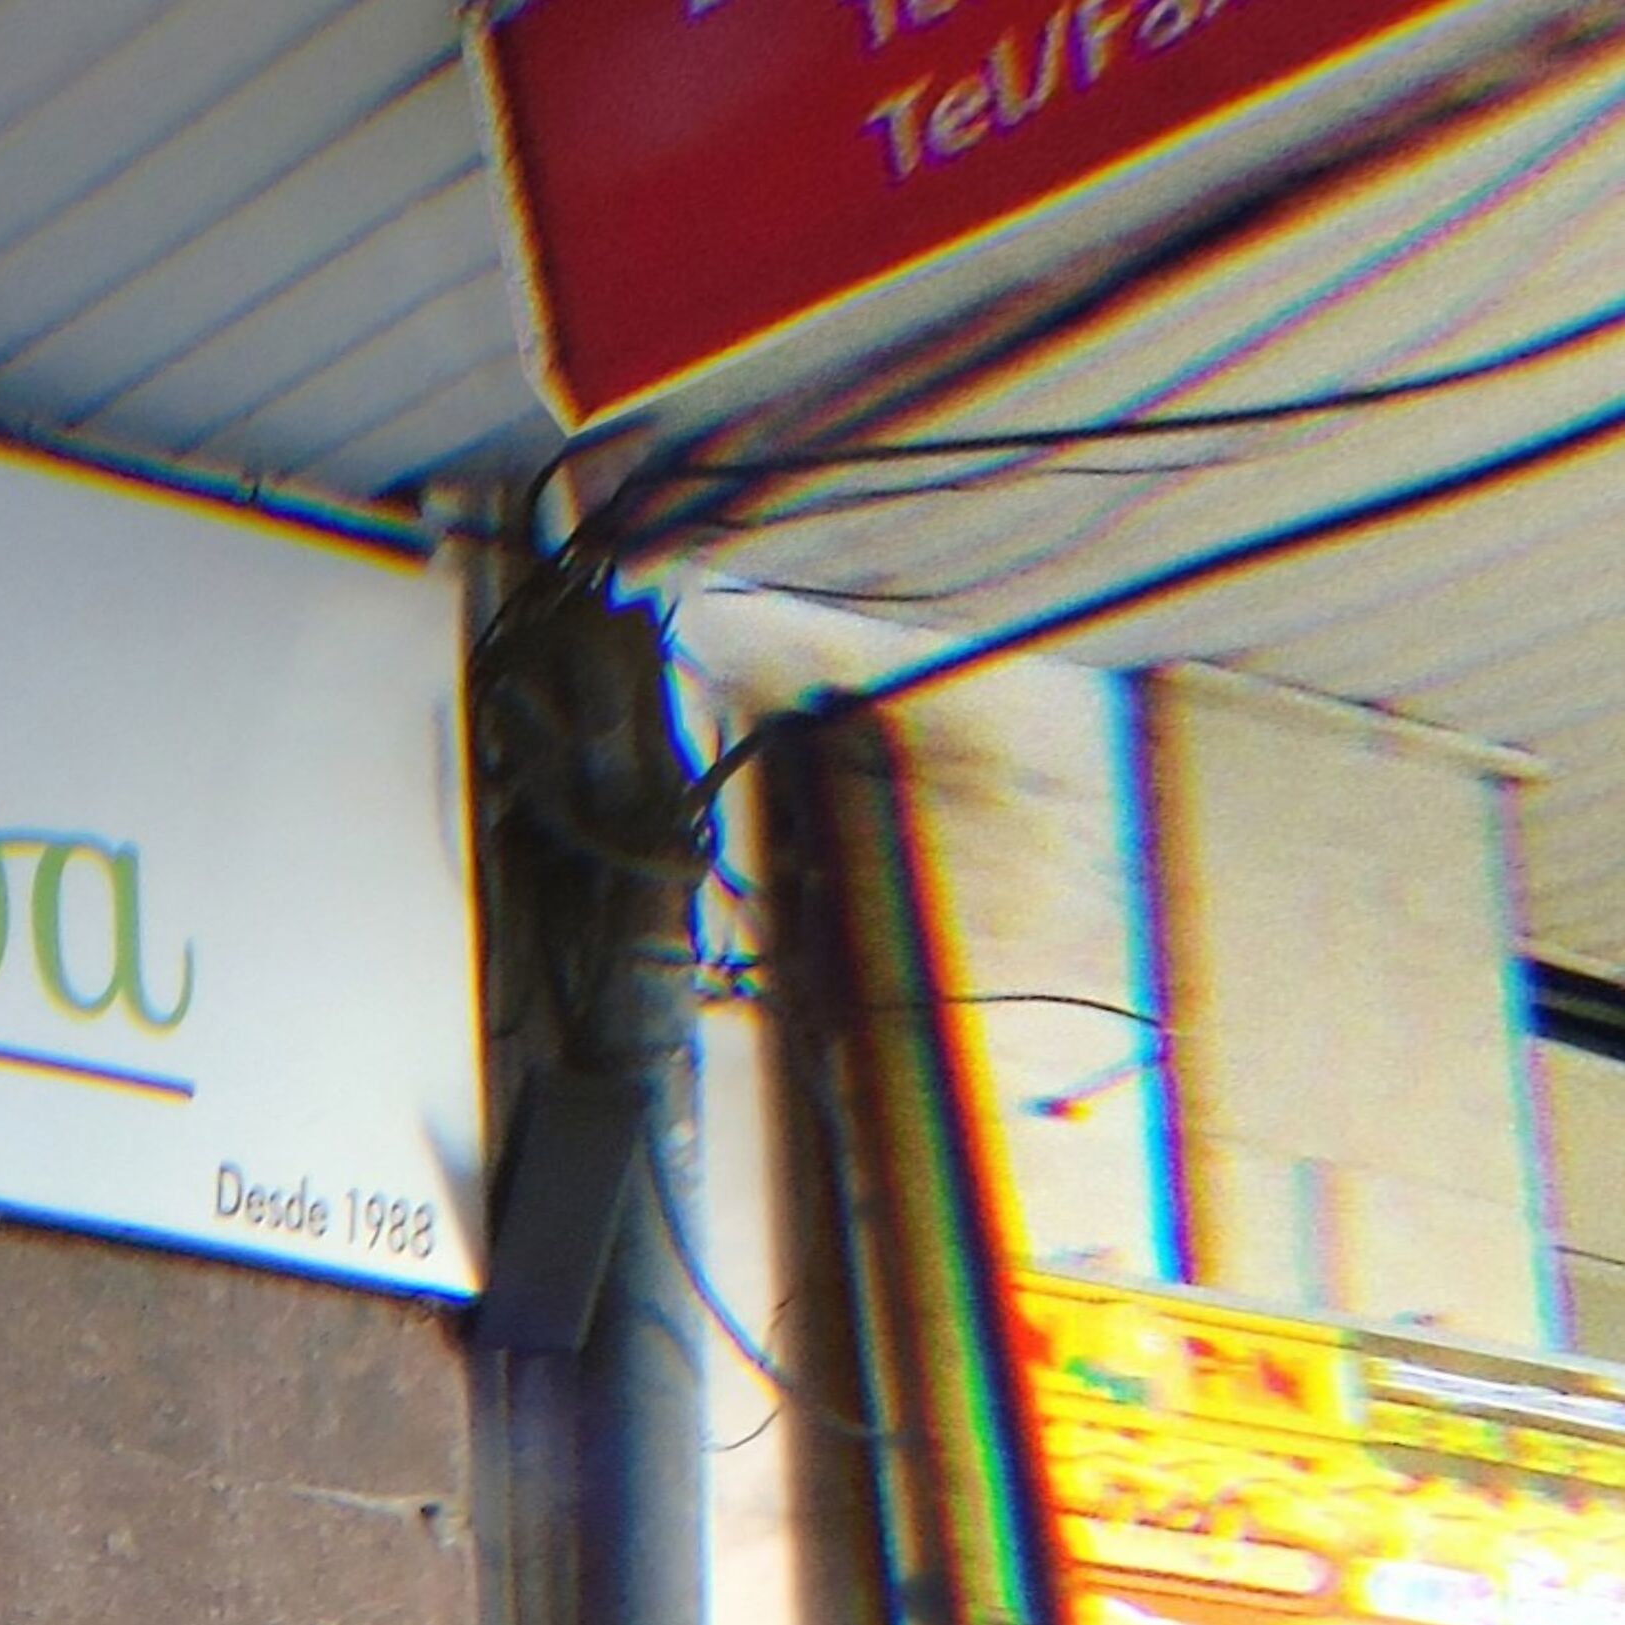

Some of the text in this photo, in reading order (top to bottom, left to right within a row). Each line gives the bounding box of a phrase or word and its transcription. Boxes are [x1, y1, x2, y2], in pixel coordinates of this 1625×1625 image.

[861, 0, 1235, 186] Tel/Fa
[215, 1161, 437, 1260] Desde 1988
